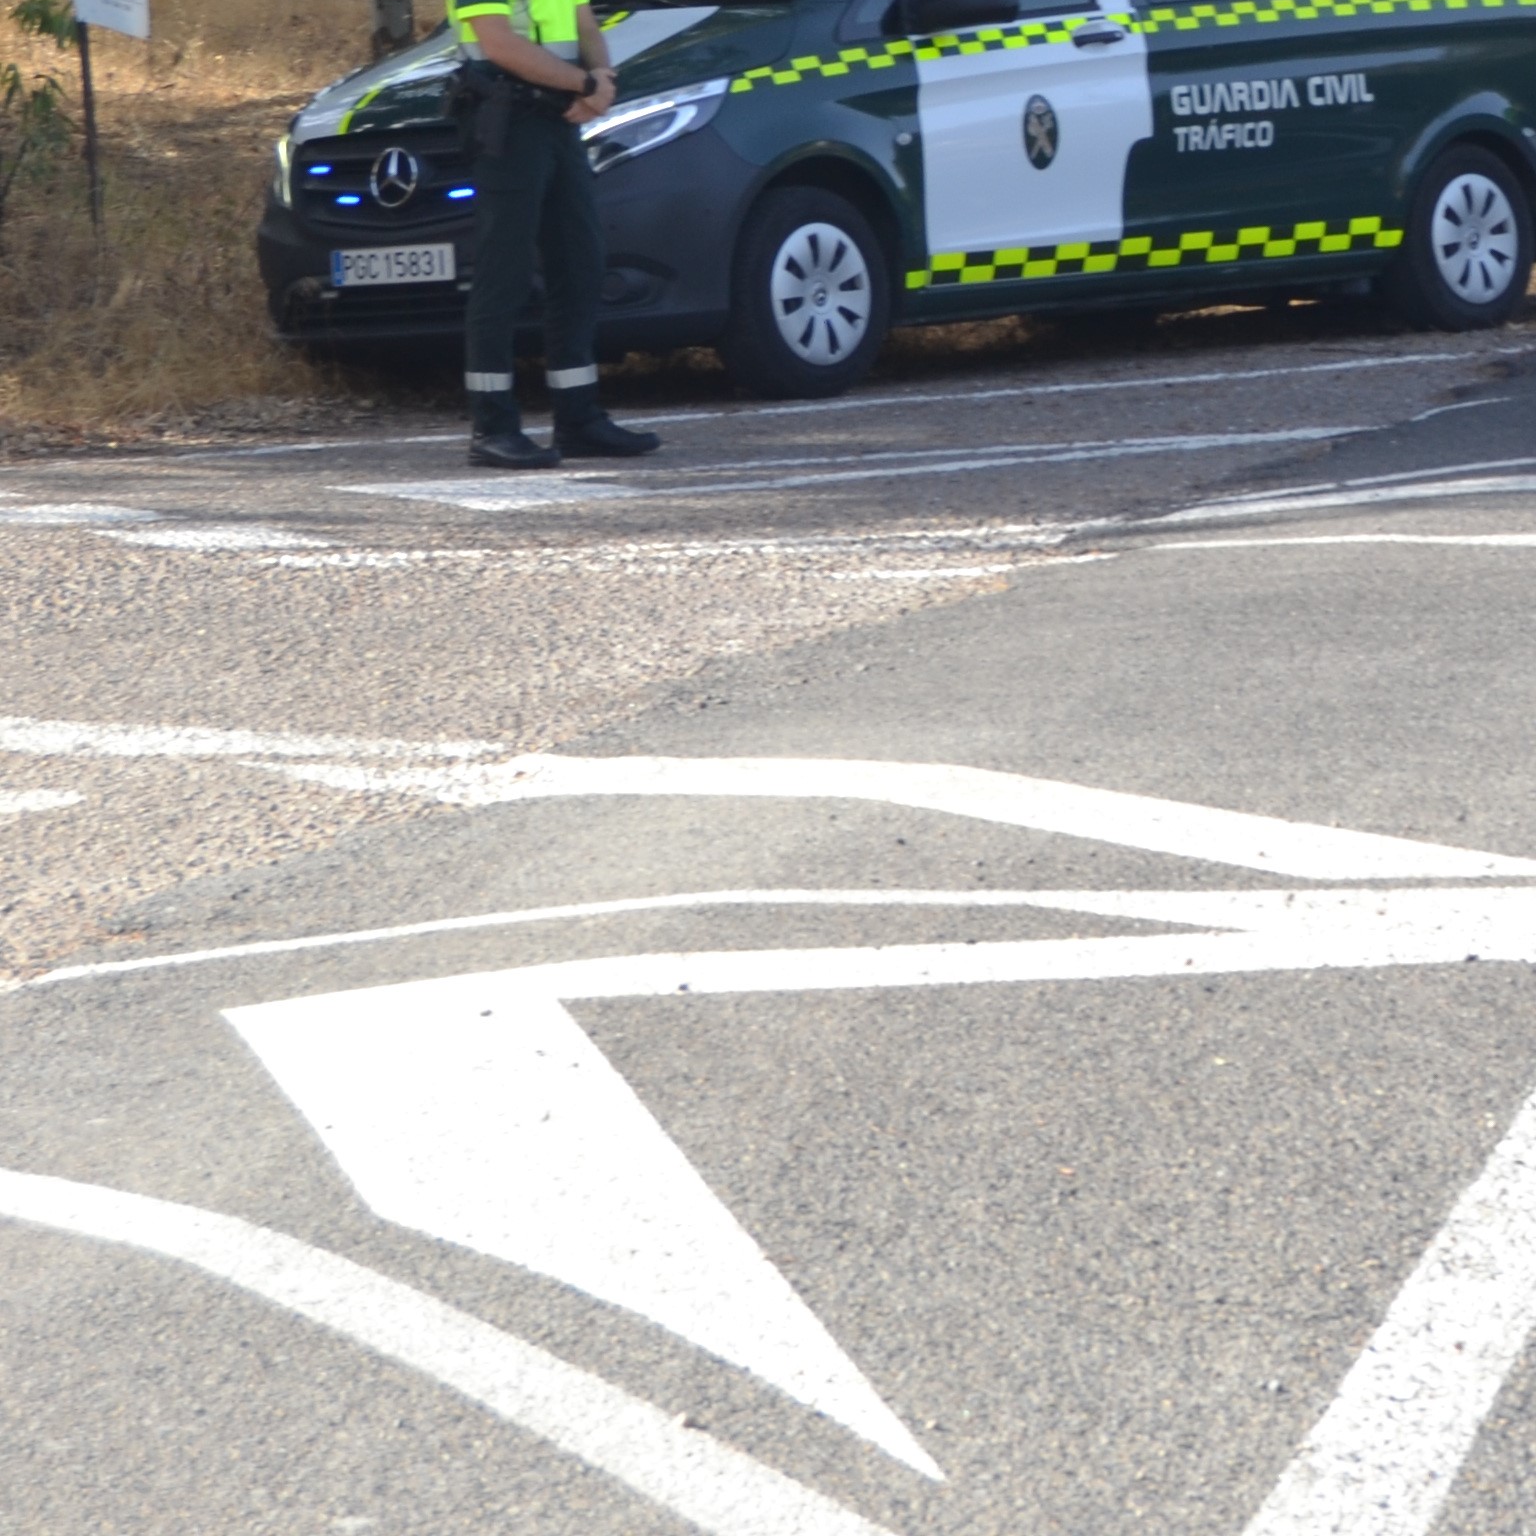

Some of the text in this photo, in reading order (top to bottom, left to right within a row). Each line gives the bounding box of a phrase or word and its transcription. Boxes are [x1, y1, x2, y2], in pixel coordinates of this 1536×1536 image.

[1170, 73, 1375, 116] GUARDIA CIVIL
[1173, 119, 1274, 152] TRÁFICO
